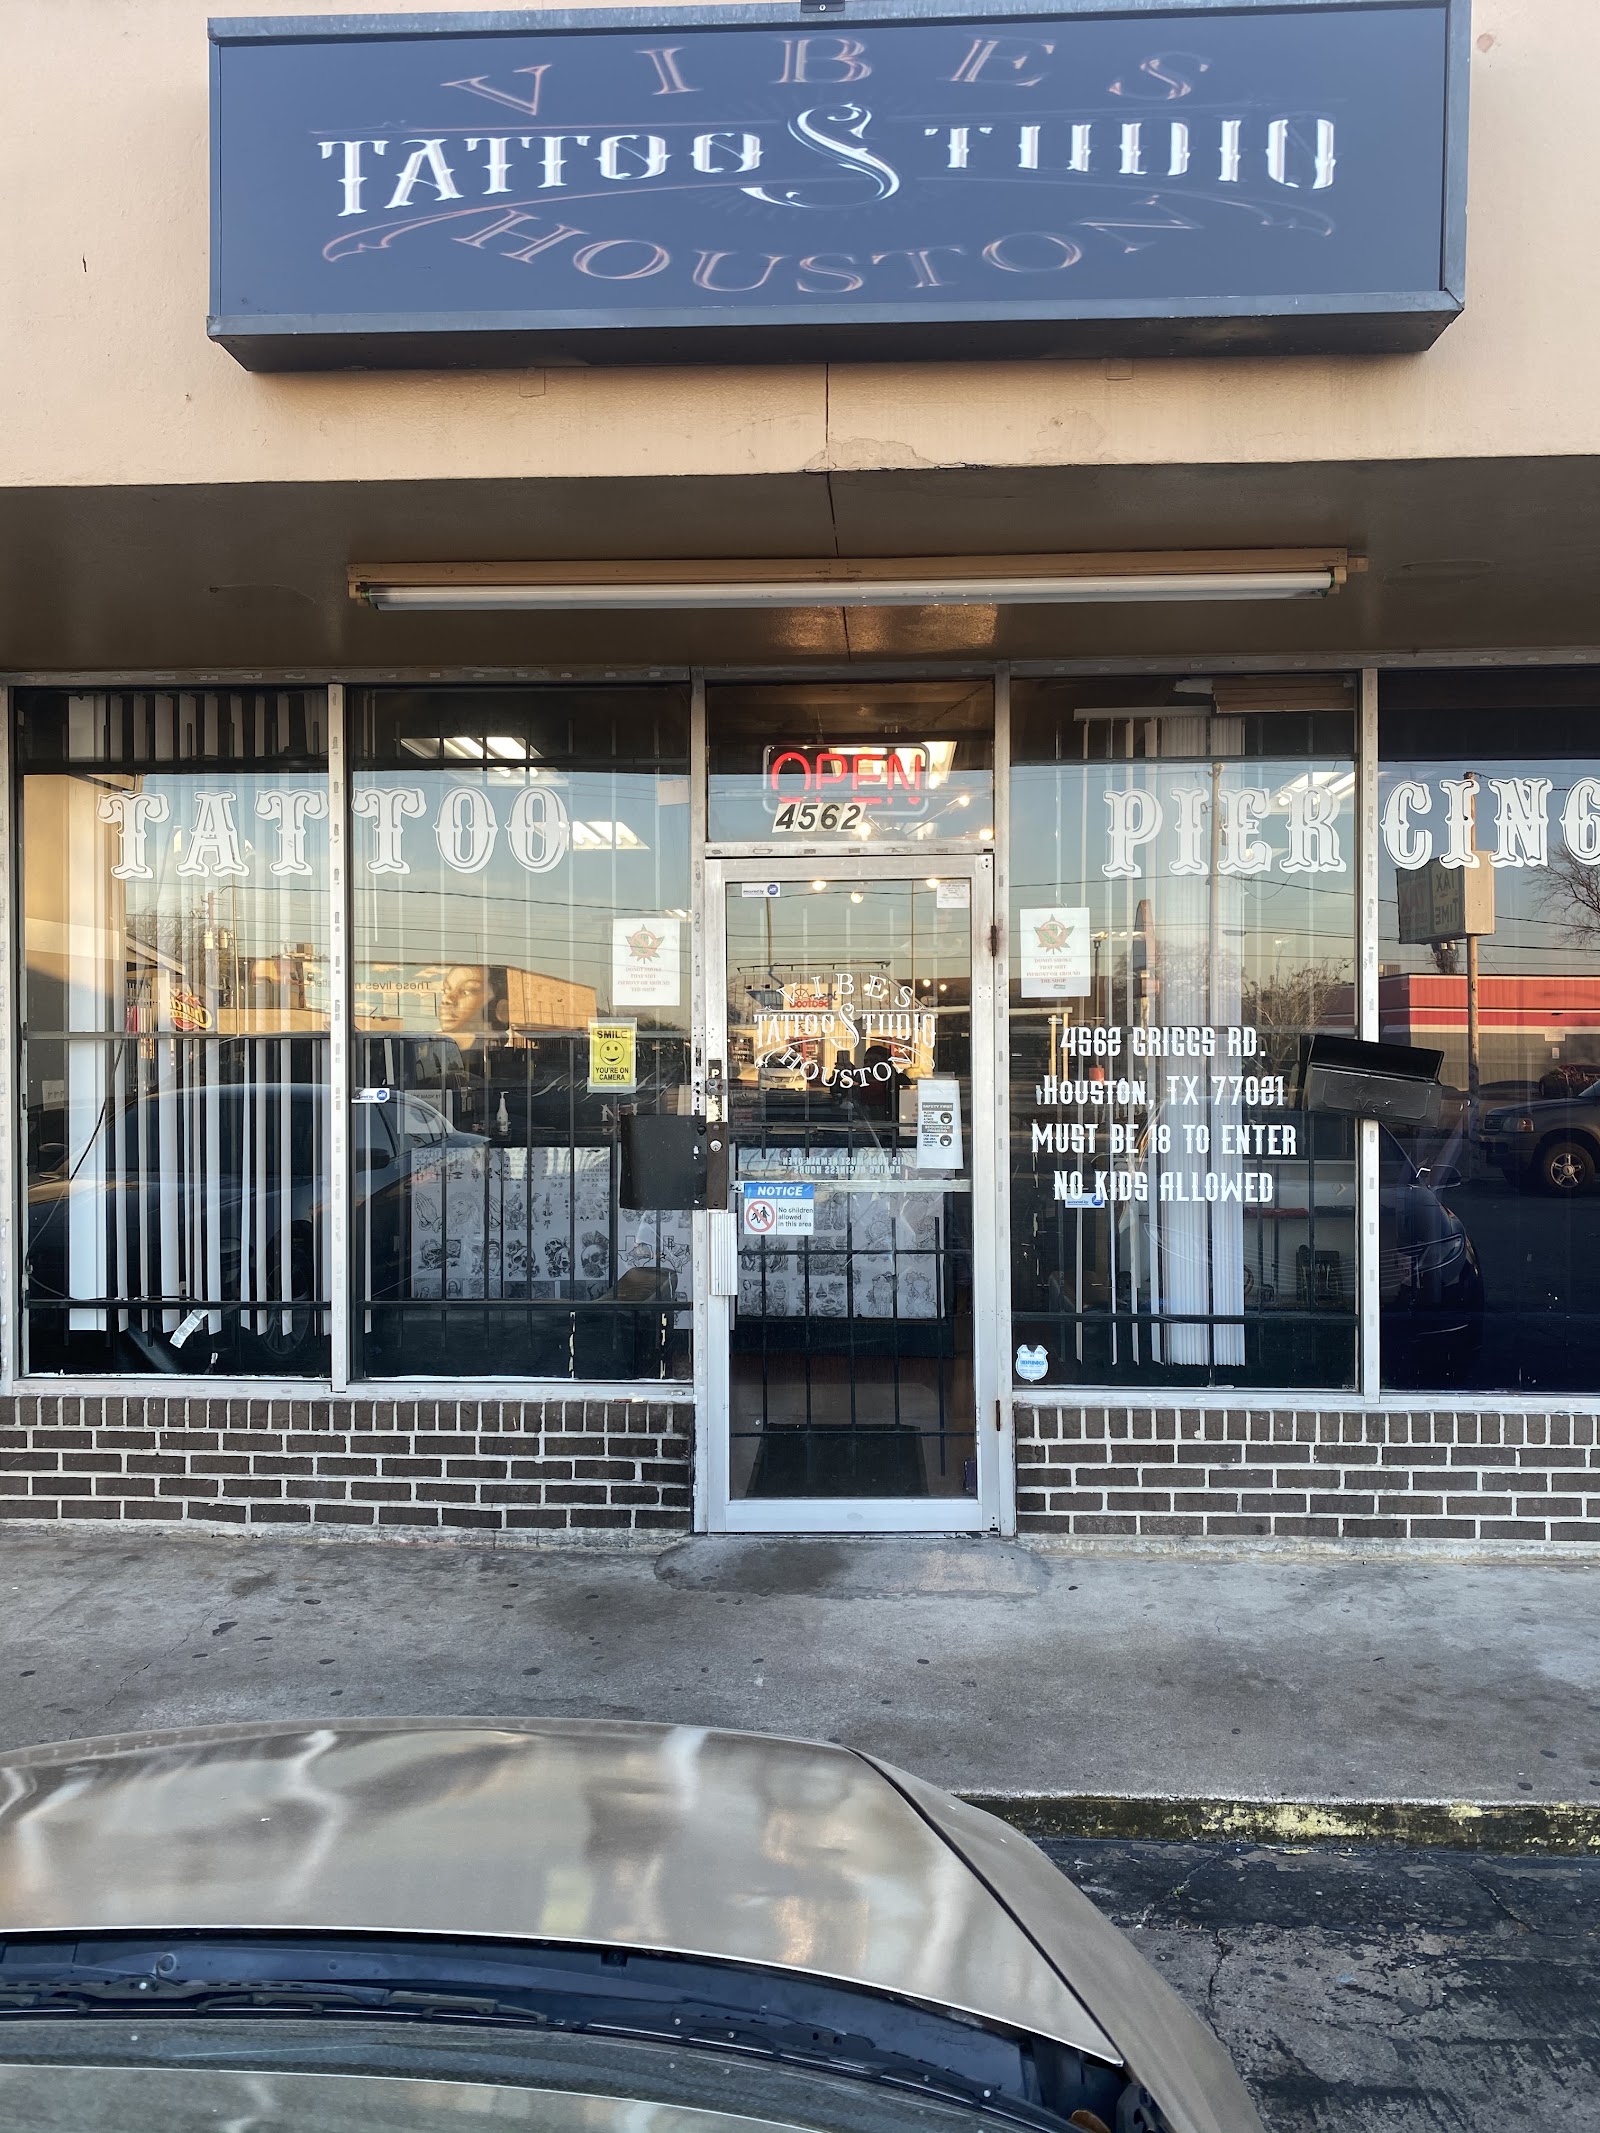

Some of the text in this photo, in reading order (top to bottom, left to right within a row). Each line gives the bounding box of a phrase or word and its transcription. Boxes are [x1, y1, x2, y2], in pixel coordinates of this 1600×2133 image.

[441, 35, 1212, 117] VIBES
[317, 103, 1338, 217] TATTOO STUDIO
[452, 195, 1202, 294] HOUSTON
[771, 752, 922, 805] OPEN
[775, 803, 861, 830] 4562
[776, 973, 914, 1008] VIBES
[596, 1030, 628, 1039] SMILE
[754, 1002, 936, 1051] TATTOO STUDIO
[1060, 1026, 1266, 1057] 4562 GRIGGS RD.
[778, 1046, 912, 1089] HOUSTON
[1166, 1075, 1199, 1106] TX
[1210, 1075, 1286, 1106] 77021
[1030, 1122, 1298, 1156] MUST BE 18 TO ENTER
[757, 1186, 804, 1196] NOTICE
[1053, 1170, 1274, 1204] NO KIDS ALLOWED
